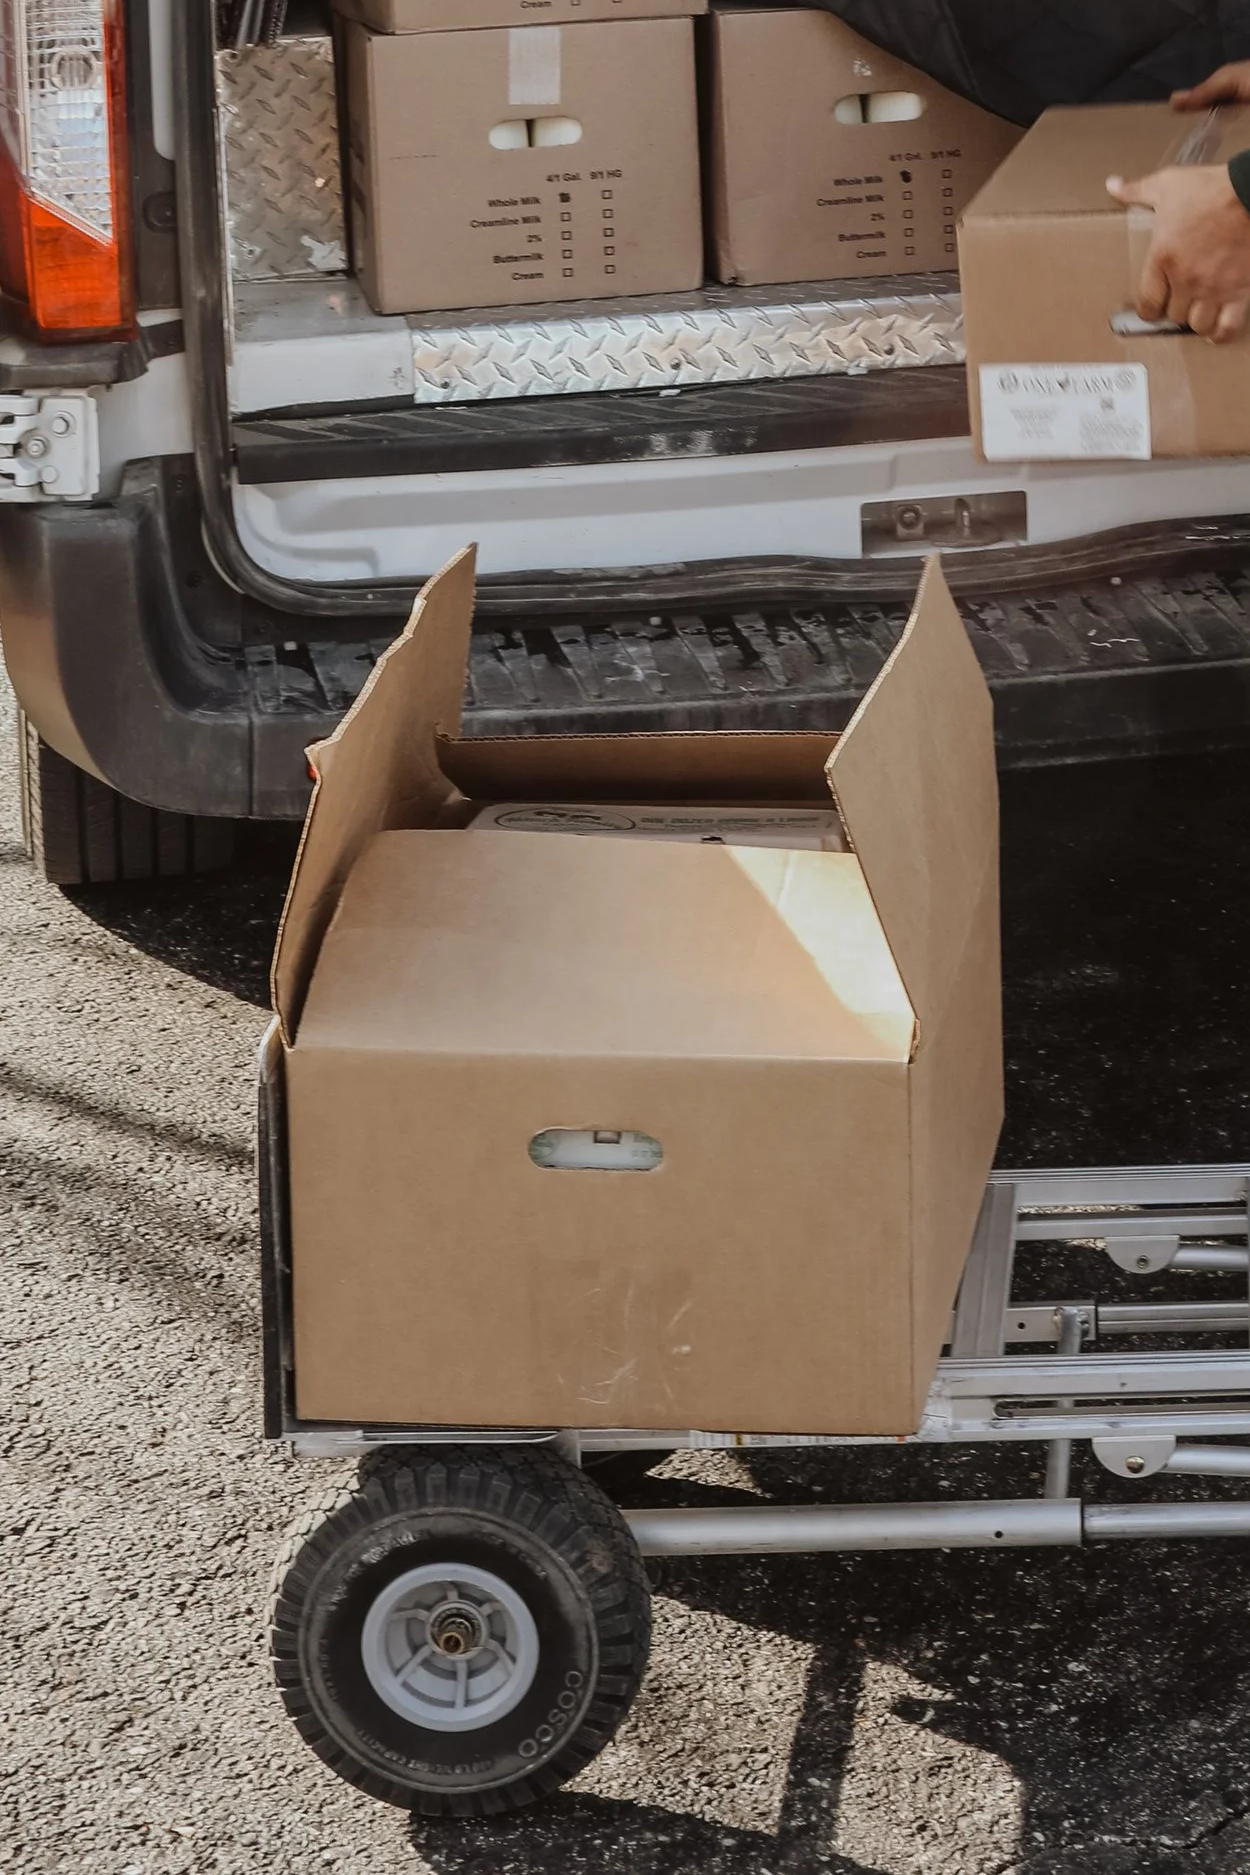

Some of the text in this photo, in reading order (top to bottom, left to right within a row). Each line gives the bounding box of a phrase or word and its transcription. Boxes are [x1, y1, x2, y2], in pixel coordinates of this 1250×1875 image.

[520, 0, 552, 9] Cream
[606, 169, 622, 178] HG
[833, 175, 883, 186] Whole Milk
[488, 196, 541, 208] Whole Milk
[817, 194, 884, 206] Creamline Milk
[470, 215, 541, 228] Creamline Milk
[870, 213, 885, 222] 2%
[526, 234, 543, 243] 2%
[838, 231, 886, 242] Buttermilk
[493, 252, 544, 264] Buttermilk
[856, 251, 887, 259] Cream
[511, 272, 544, 281] Cream
[518, 1670, 584, 1758] COSCO
